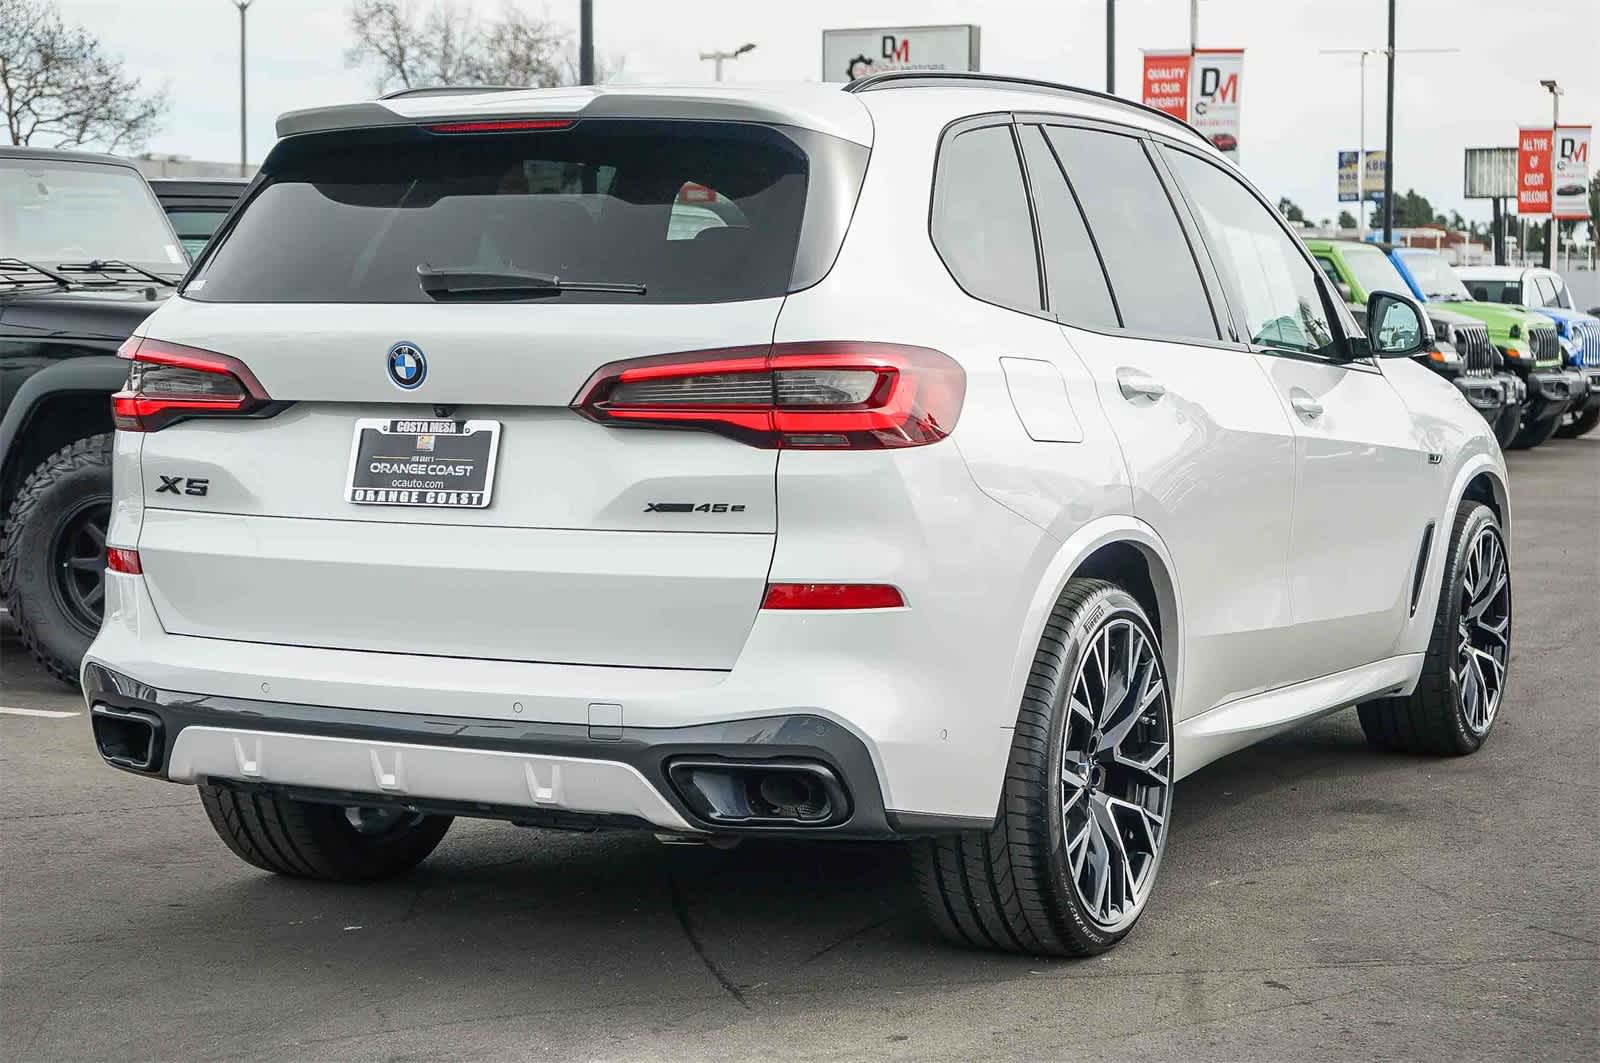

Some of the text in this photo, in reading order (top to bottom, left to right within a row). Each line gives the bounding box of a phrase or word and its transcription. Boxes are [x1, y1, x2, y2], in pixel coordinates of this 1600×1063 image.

[882, 35, 910, 63] DM
[1147, 67, 1186, 80] QUALITY
[1151, 82, 1181, 93] IS OUR
[1200, 67, 1238, 103] DM
[1522, 138, 1548, 151] ALL TYPE
[1560, 138, 1588, 162] DM
[1524, 173, 1545, 186] CREDIT
[1520, 190, 1549, 203] WELCOME
[396, 420, 457, 433] COSTA MESA
[369, 462, 474, 477] ORANGE COAST
[155, 475, 210, 497] X5
[391, 478, 444, 489] ocauto.com
[354, 490, 481, 505] ORANGE COAST
[1082, 604, 1105, 634] PIRELLI
